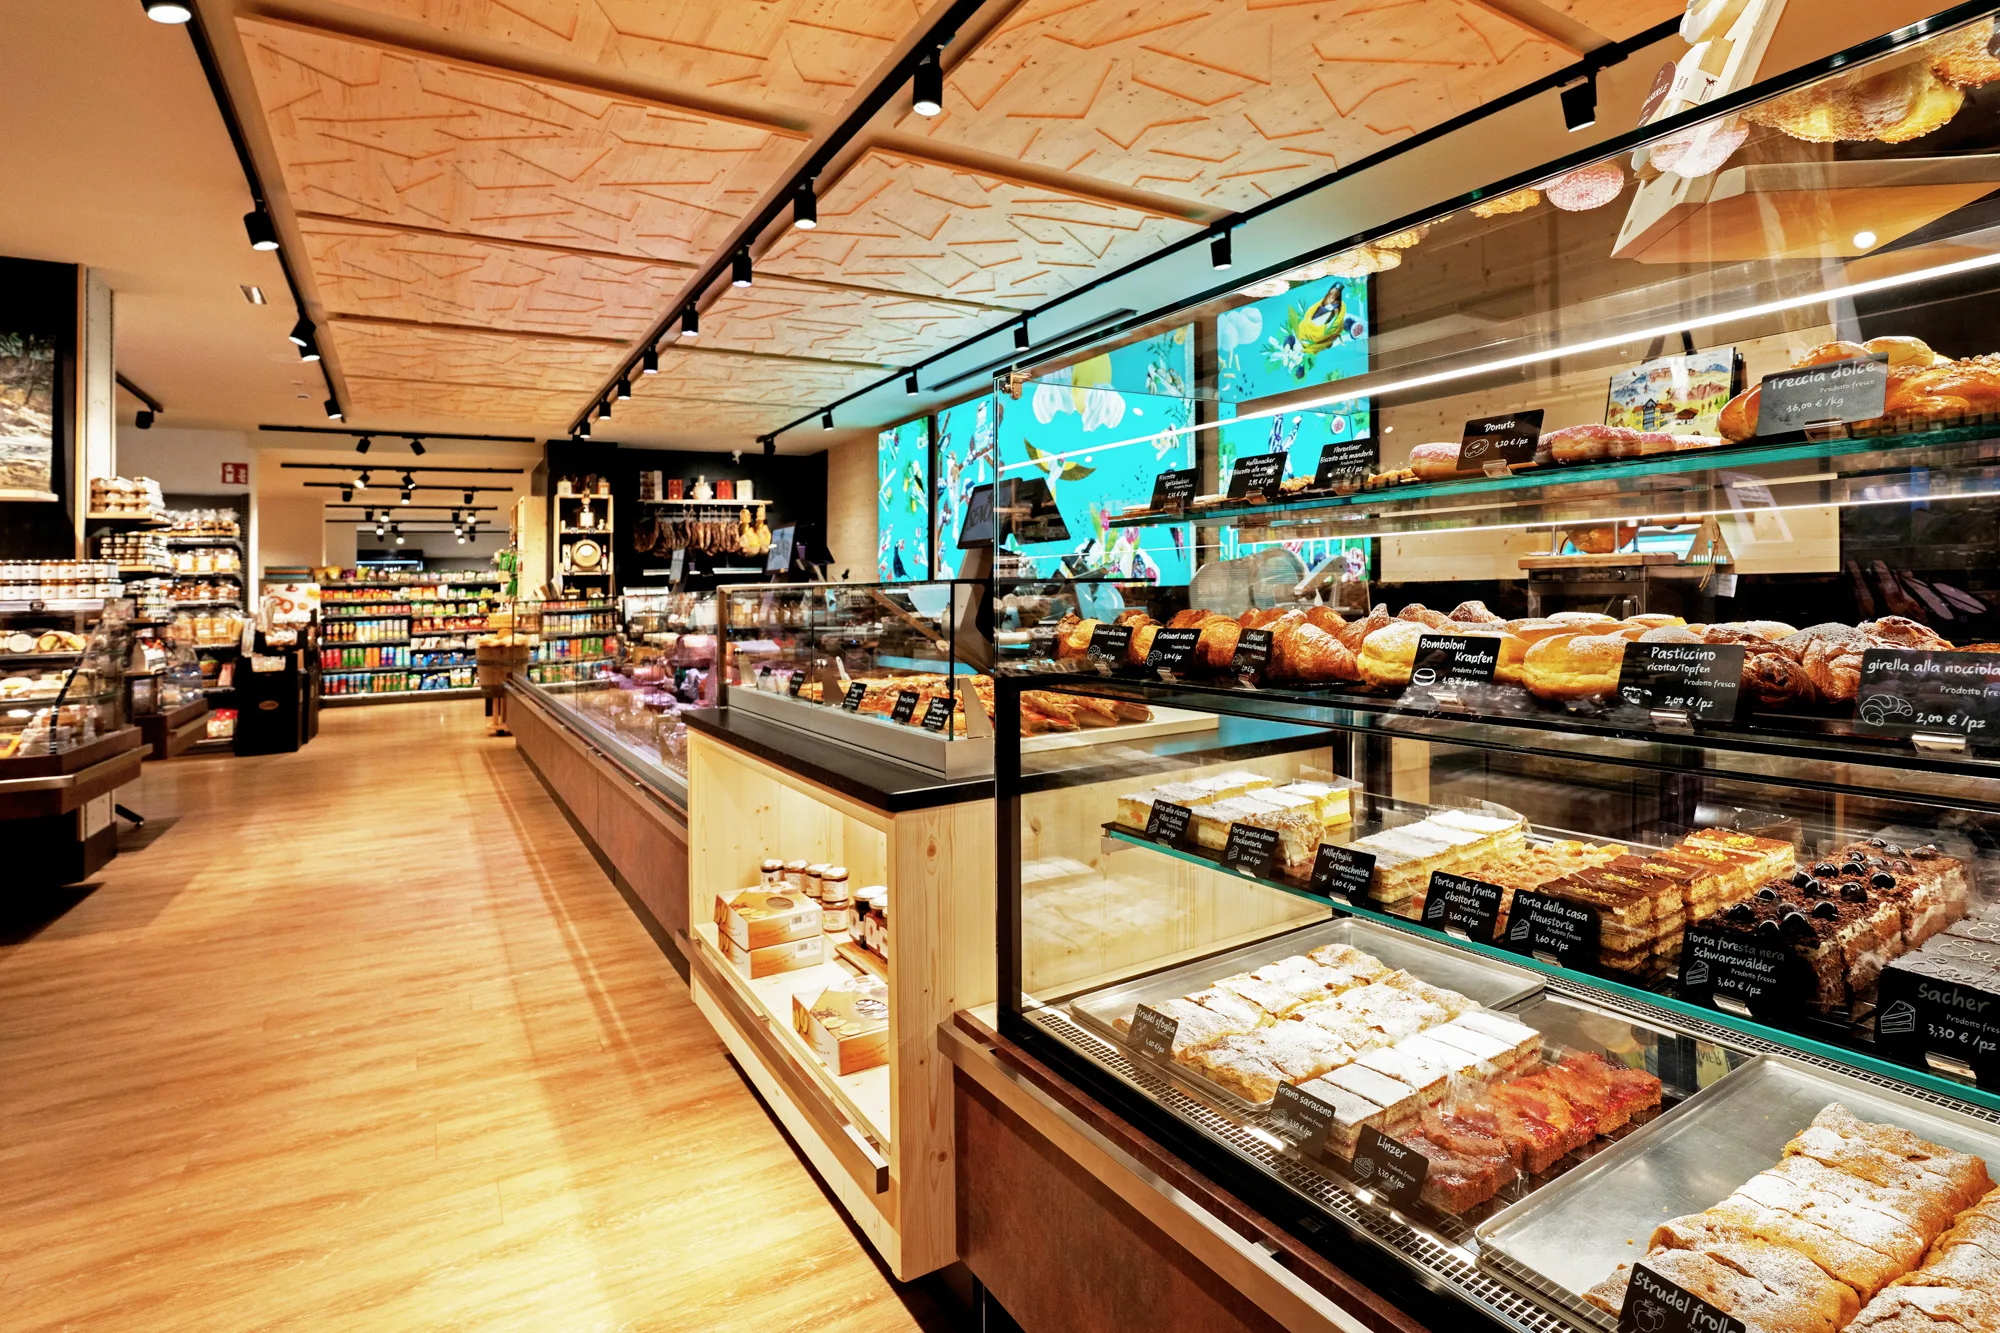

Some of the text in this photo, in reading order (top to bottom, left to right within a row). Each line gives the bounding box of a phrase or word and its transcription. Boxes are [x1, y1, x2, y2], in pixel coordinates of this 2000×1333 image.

[1770, 361, 1876, 390] Treccia dolce
[1820, 379, 1875, 393] Prodotto fresco
[1786, 396, 1844, 413] 16,00 € /kg
[1484, 420, 1515, 432] Donuts
[1333, 444, 1361, 453] Florentiner
[1516, 438, 1528, 447] /pz
[1349, 449, 1373, 458] mandorle
[1421, 638, 1466, 650] Bomboloni
[1455, 651, 1493, 664] Krapfen
[1651, 646, 1716, 661] Pasticcino
[1472, 667, 1488, 675] fresco
[1647, 662, 1710, 676] ricotta/Topfen
[1867, 659, 2000, 675] girella alla nocciola
[1713, 680, 1736, 688] fresco
[1940, 686, 2000, 698] Prodotto fre
[1665, 696, 1713, 712] 2,00 € /pz
[1916, 712, 1986, 732] 2,00 € /pz
[1154, 802, 1189, 818] Torta alla ricotta
[1232, 826, 1275, 842] Torta pasta choux
[1233, 836, 1262, 848] Flockentorte
[1323, 848, 1352, 863] Millefoglie
[1329, 861, 1369, 878] Cremschnitte
[1434, 876, 1497, 899] Torta alla frutta
[1445, 891, 1480, 908] Obsttorte
[1460, 905, 1490, 918] Prodotto fresco
[1519, 895, 1588, 921] Torta della casa
[1449, 912, 1462, 921] 3,60
[1468, 917, 1479, 928] /pz
[1530, 911, 1574, 932] Haustorte
[1547, 927, 1582, 941] Prodotto fresco
[1535, 934, 1549, 944] 3,60
[1557, 940, 1569, 951] /pz
[1688, 932, 1784, 961] Torta foresta nera
[1694, 947, 1775, 972] Schwarzwälder
[1731, 968, 1776, 984] Prodotto fresco
[1717, 977, 1761, 997] 3,60 € /pz
[1918, 983, 1991, 1012] Sacher
[1135, 1007, 1175, 1033] Strudel sfoglia
[1946, 1014, 1980, 1028] Prodotto
[1928, 1024, 1996, 1053] 3,30 € /pz
[1278, 1083, 1332, 1117] Grano saraceno
[1377, 1135, 1407, 1160] Linzer
[1377, 1168, 1389, 1179] 3,30
[1634, 1272, 1690, 1314] Strudel
